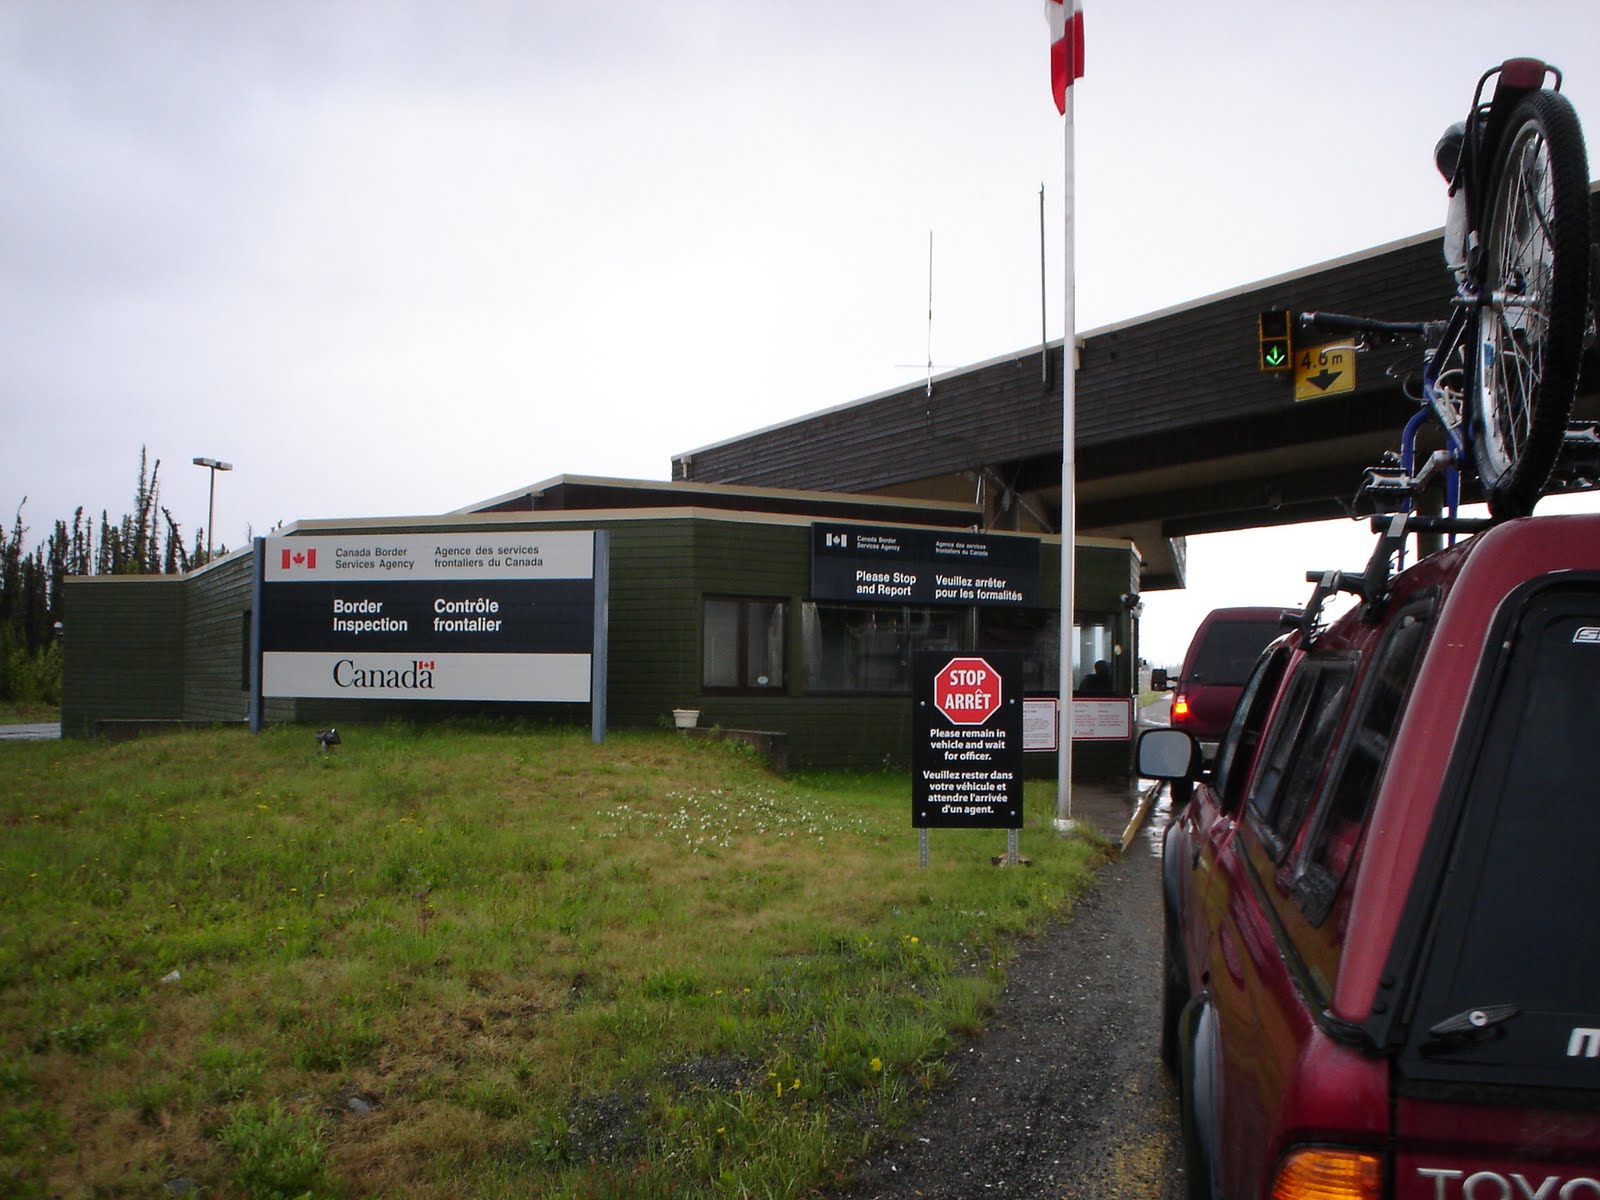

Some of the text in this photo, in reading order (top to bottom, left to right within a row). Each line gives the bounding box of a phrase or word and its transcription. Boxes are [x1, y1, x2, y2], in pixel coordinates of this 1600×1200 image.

[1301, 350, 1343, 370] 4.6 m
[434, 545, 539, 556] Agence des services
[857, 542, 900, 552] Services Agency
[936, 541, 954, 550] Agence
[335, 547, 407, 557] Canada Border
[335, 559, 414, 570] Services Agency
[434, 558, 543, 568] frontaliers du Canada
[856, 571, 917, 585] Please Stop
[936, 575, 1006, 589] Veuillez arrêter
[856, 584, 912, 597] and Report
[935, 588, 1023, 602] pour les formalités
[333, 599, 383, 613] Border
[434, 598, 499, 613] Contrôle
[333, 617, 408, 634] Inspection
[434, 617, 502, 632] frontalier
[333, 660, 434, 689] Canada
[950, 670, 986, 686] STOP
[945, 689, 991, 710] ARRÊT
[930, 728, 1006, 738] Please remain in
[930, 740, 1006, 749] vehicle and wait
[944, 751, 992, 761] for officer.
[923, 771, 1013, 780] Veuillez rester dans
[930, 781, 1007, 791] votre véhicule et
[928, 793, 1008, 803] attendre l'arrivée
[942, 804, 994, 815] d'un agent.
